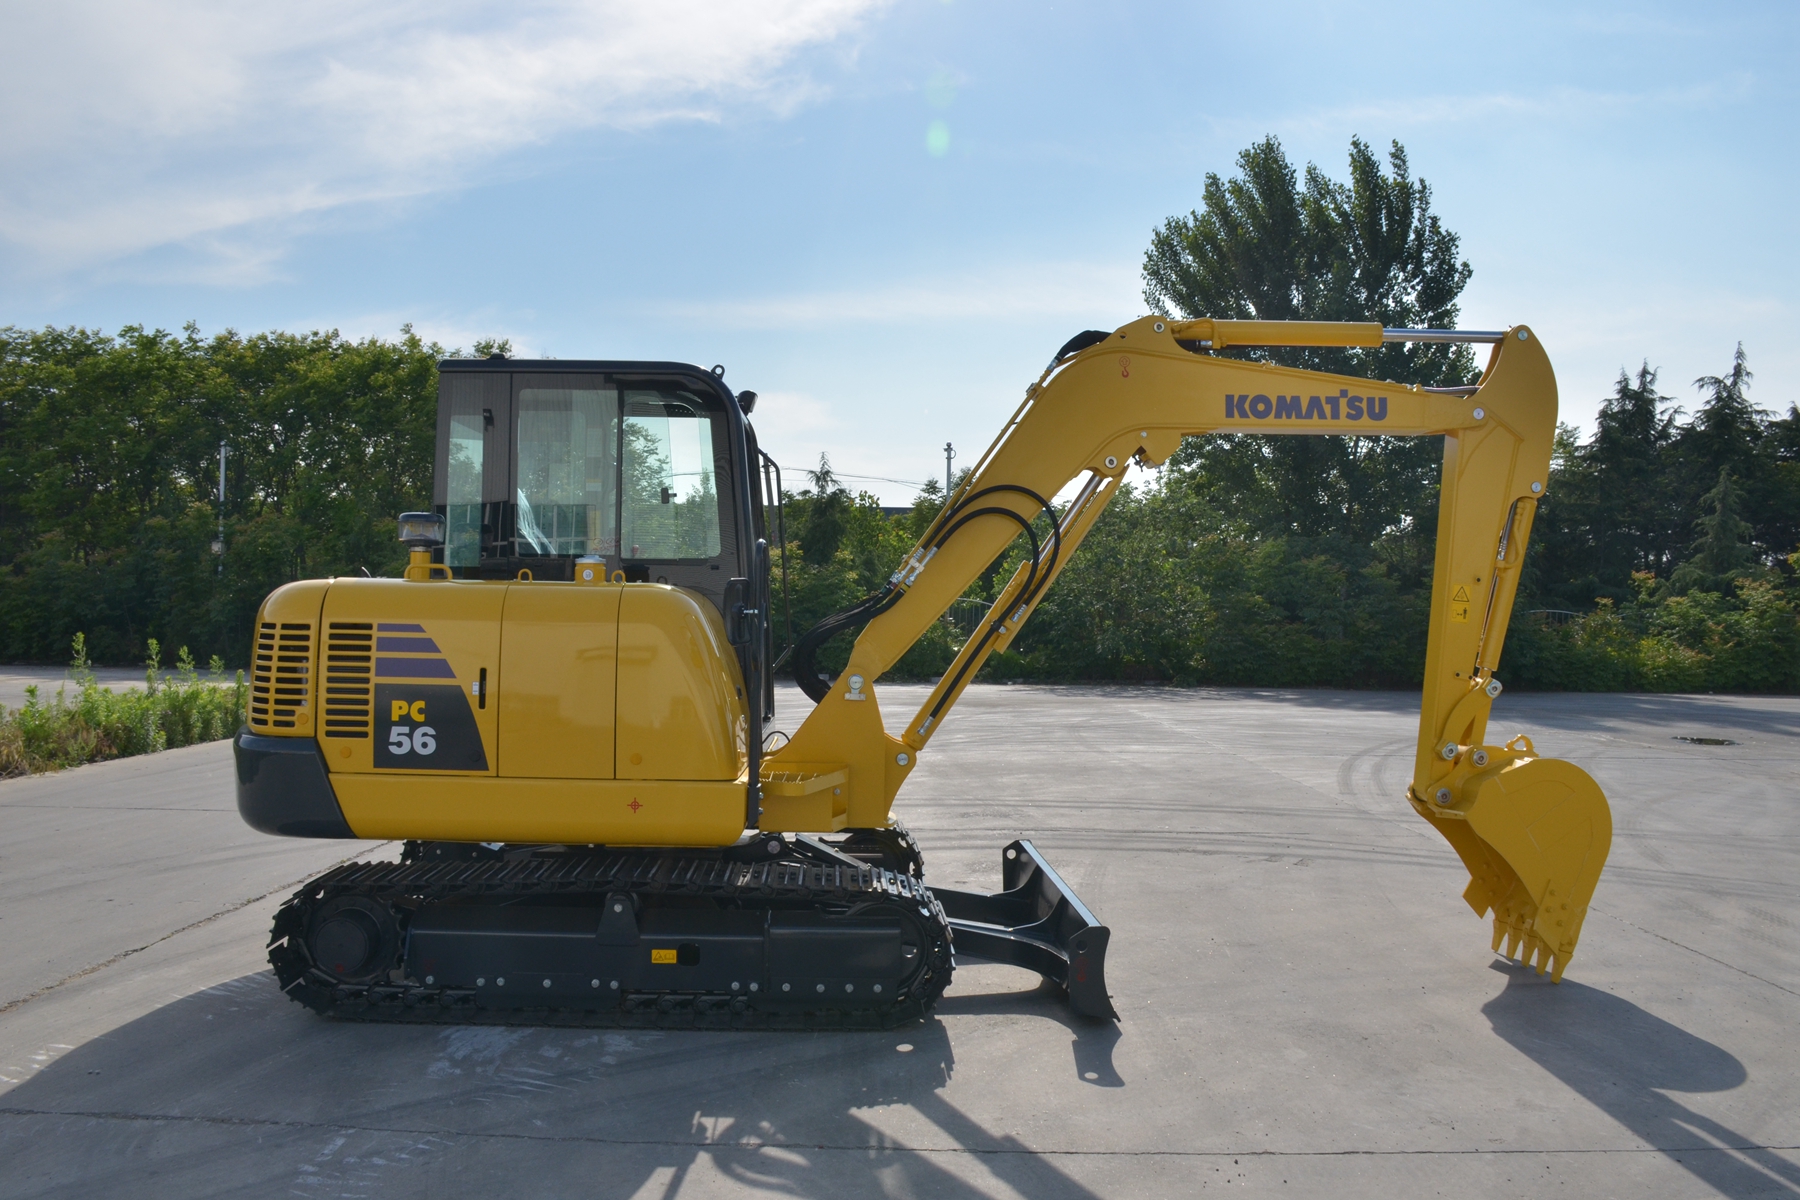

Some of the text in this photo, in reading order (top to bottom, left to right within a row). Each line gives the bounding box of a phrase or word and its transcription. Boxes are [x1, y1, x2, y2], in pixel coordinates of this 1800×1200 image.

[1225, 389, 1388, 421] KOMATSU
[391, 700, 426, 722] PC
[388, 726, 437, 756] 56
